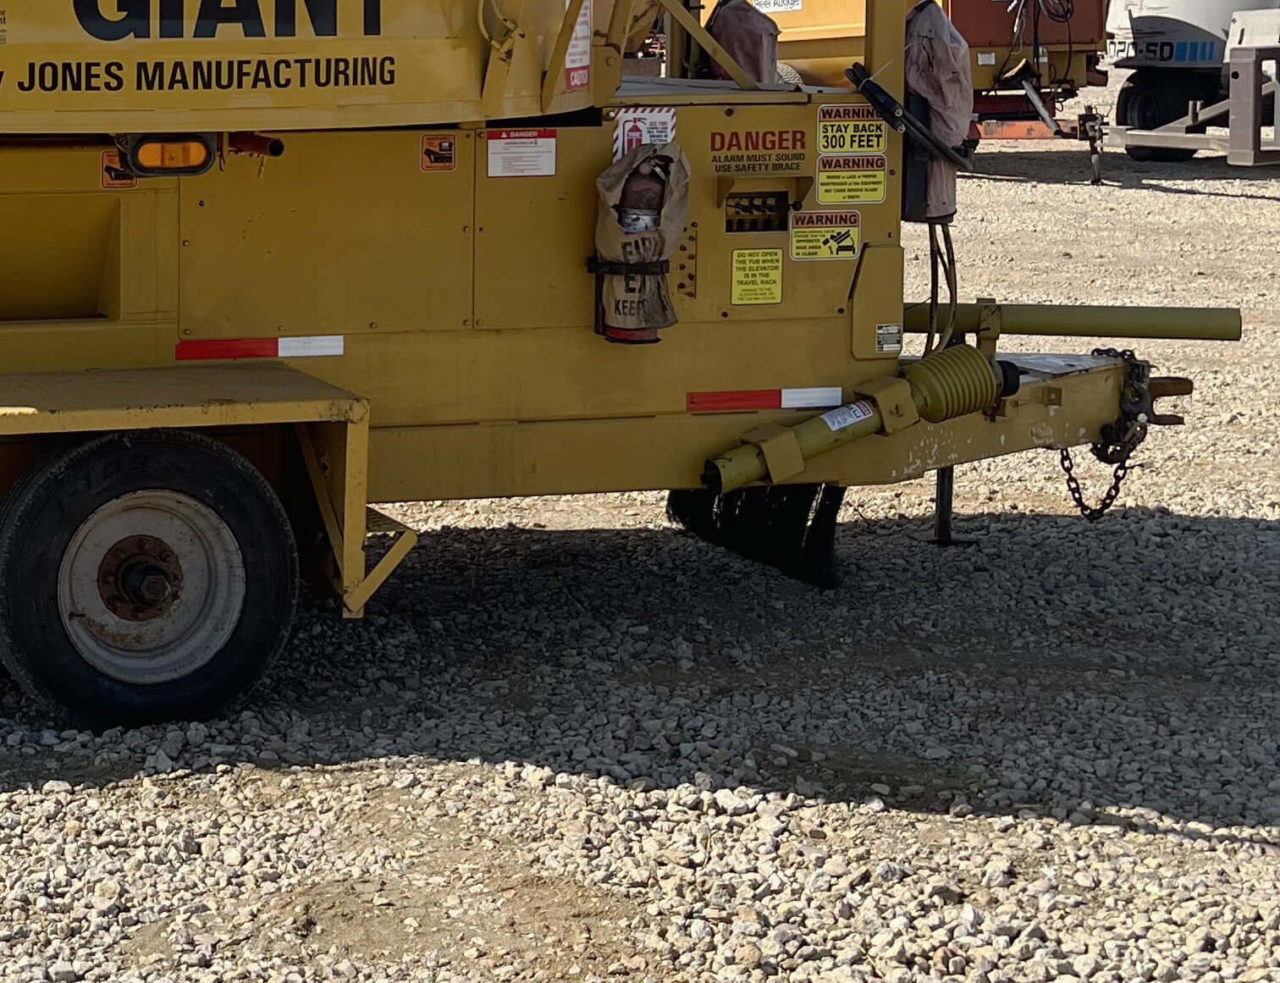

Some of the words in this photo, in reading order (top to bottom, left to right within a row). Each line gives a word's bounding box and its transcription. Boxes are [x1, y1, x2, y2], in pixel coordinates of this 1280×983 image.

[17, 61, 124, 92] JONES
[136, 56, 396, 92] MANUFACTURING
[822, 123, 849, 133] STAY
[853, 123, 883, 133] BACK
[710, 130, 806, 152] DANGER
[822, 134, 845, 149] 300
[850, 133, 882, 148] FEET
[712, 154, 744, 163] ALARM
[746, 153, 772, 162] MUST
[775, 152, 805, 161] SOUND
[715, 164, 732, 173] USE
[734, 163, 769, 172] SAFETY
[772, 162, 801, 171] BRACE
[822, 158, 885, 169] WARNING
[794, 214, 857, 226] WARNING
